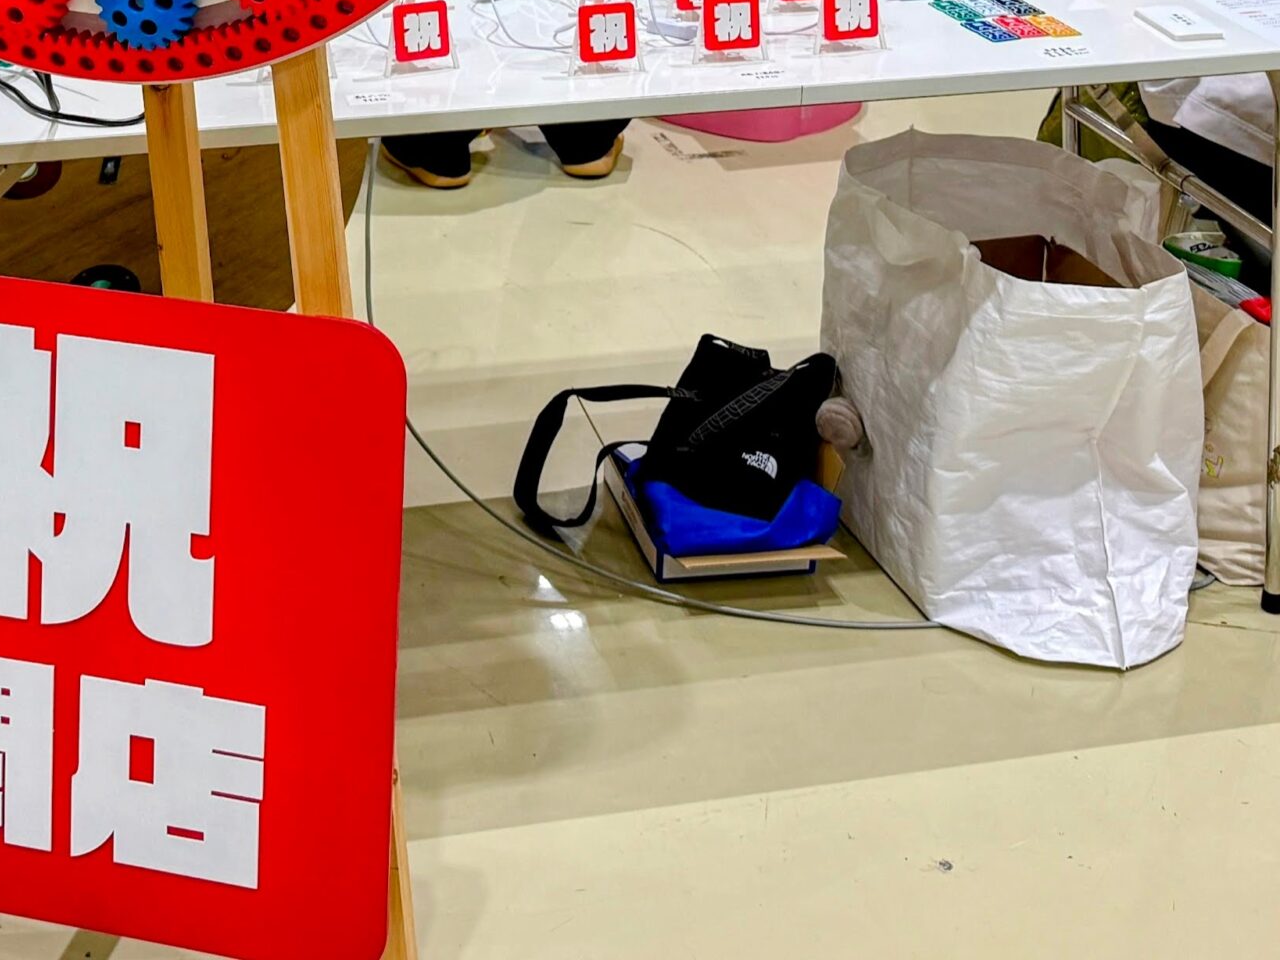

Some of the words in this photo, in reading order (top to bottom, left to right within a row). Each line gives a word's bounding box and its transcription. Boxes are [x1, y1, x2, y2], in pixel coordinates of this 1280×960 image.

[403, 11, 442, 52] 祝
[590, 12, 629, 54] 祝
[713, 1, 753, 43] 祝
